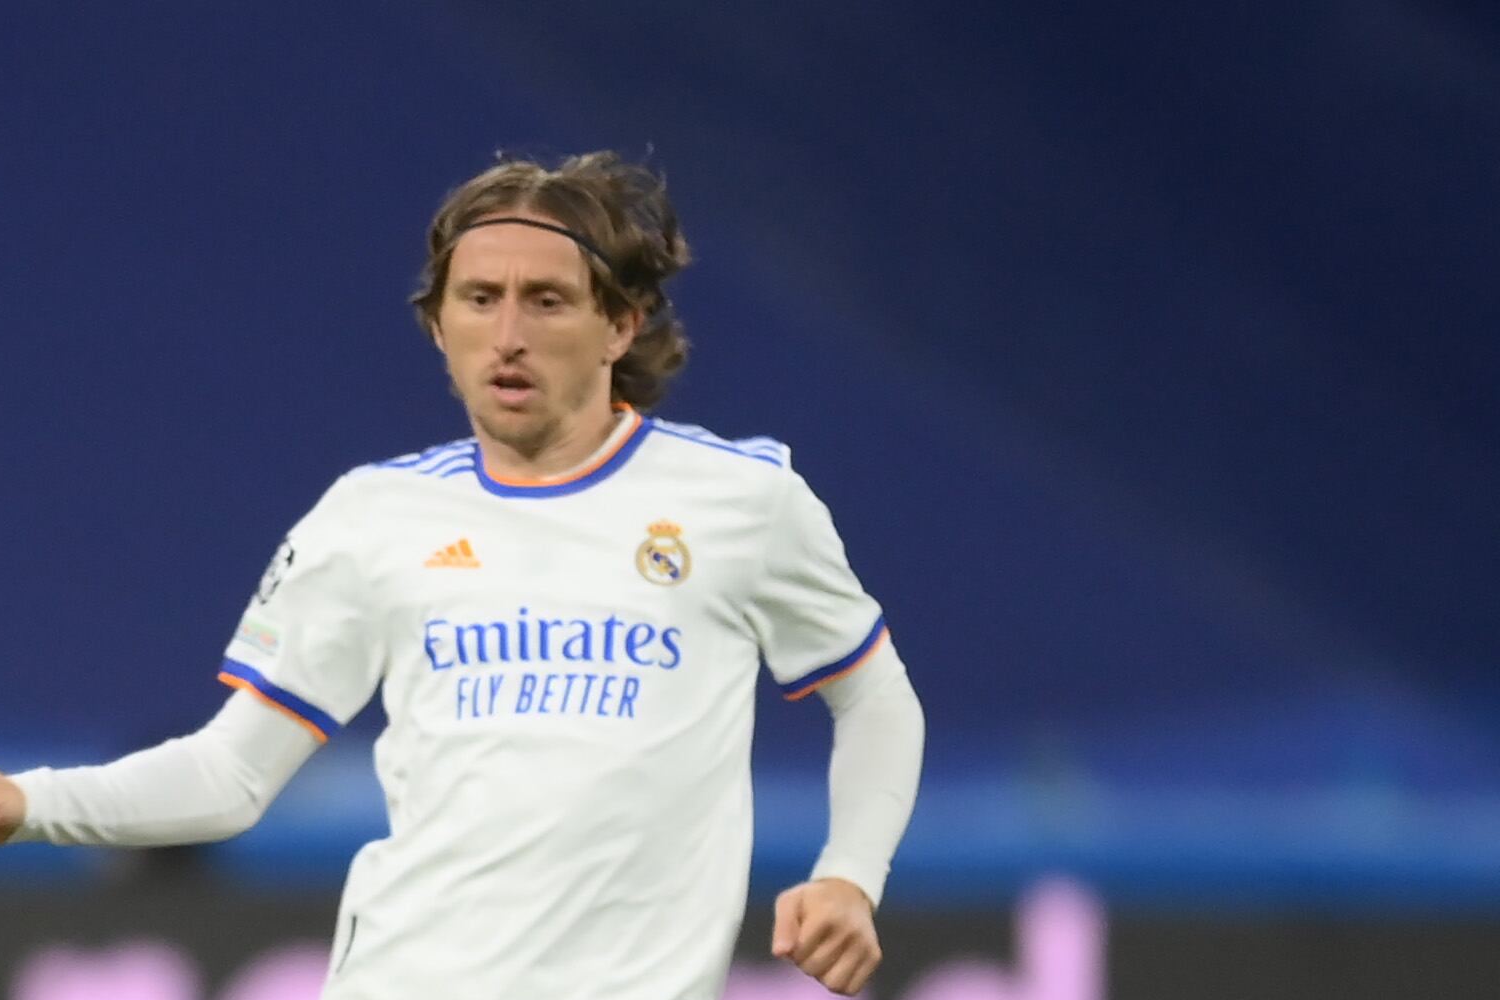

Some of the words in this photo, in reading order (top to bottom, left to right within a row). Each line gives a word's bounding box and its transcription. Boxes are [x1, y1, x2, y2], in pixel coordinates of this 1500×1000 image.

[424, 606, 682, 671] Emirates
[456, 674, 503, 720] FLY
[514, 673, 641, 719] BETTER
